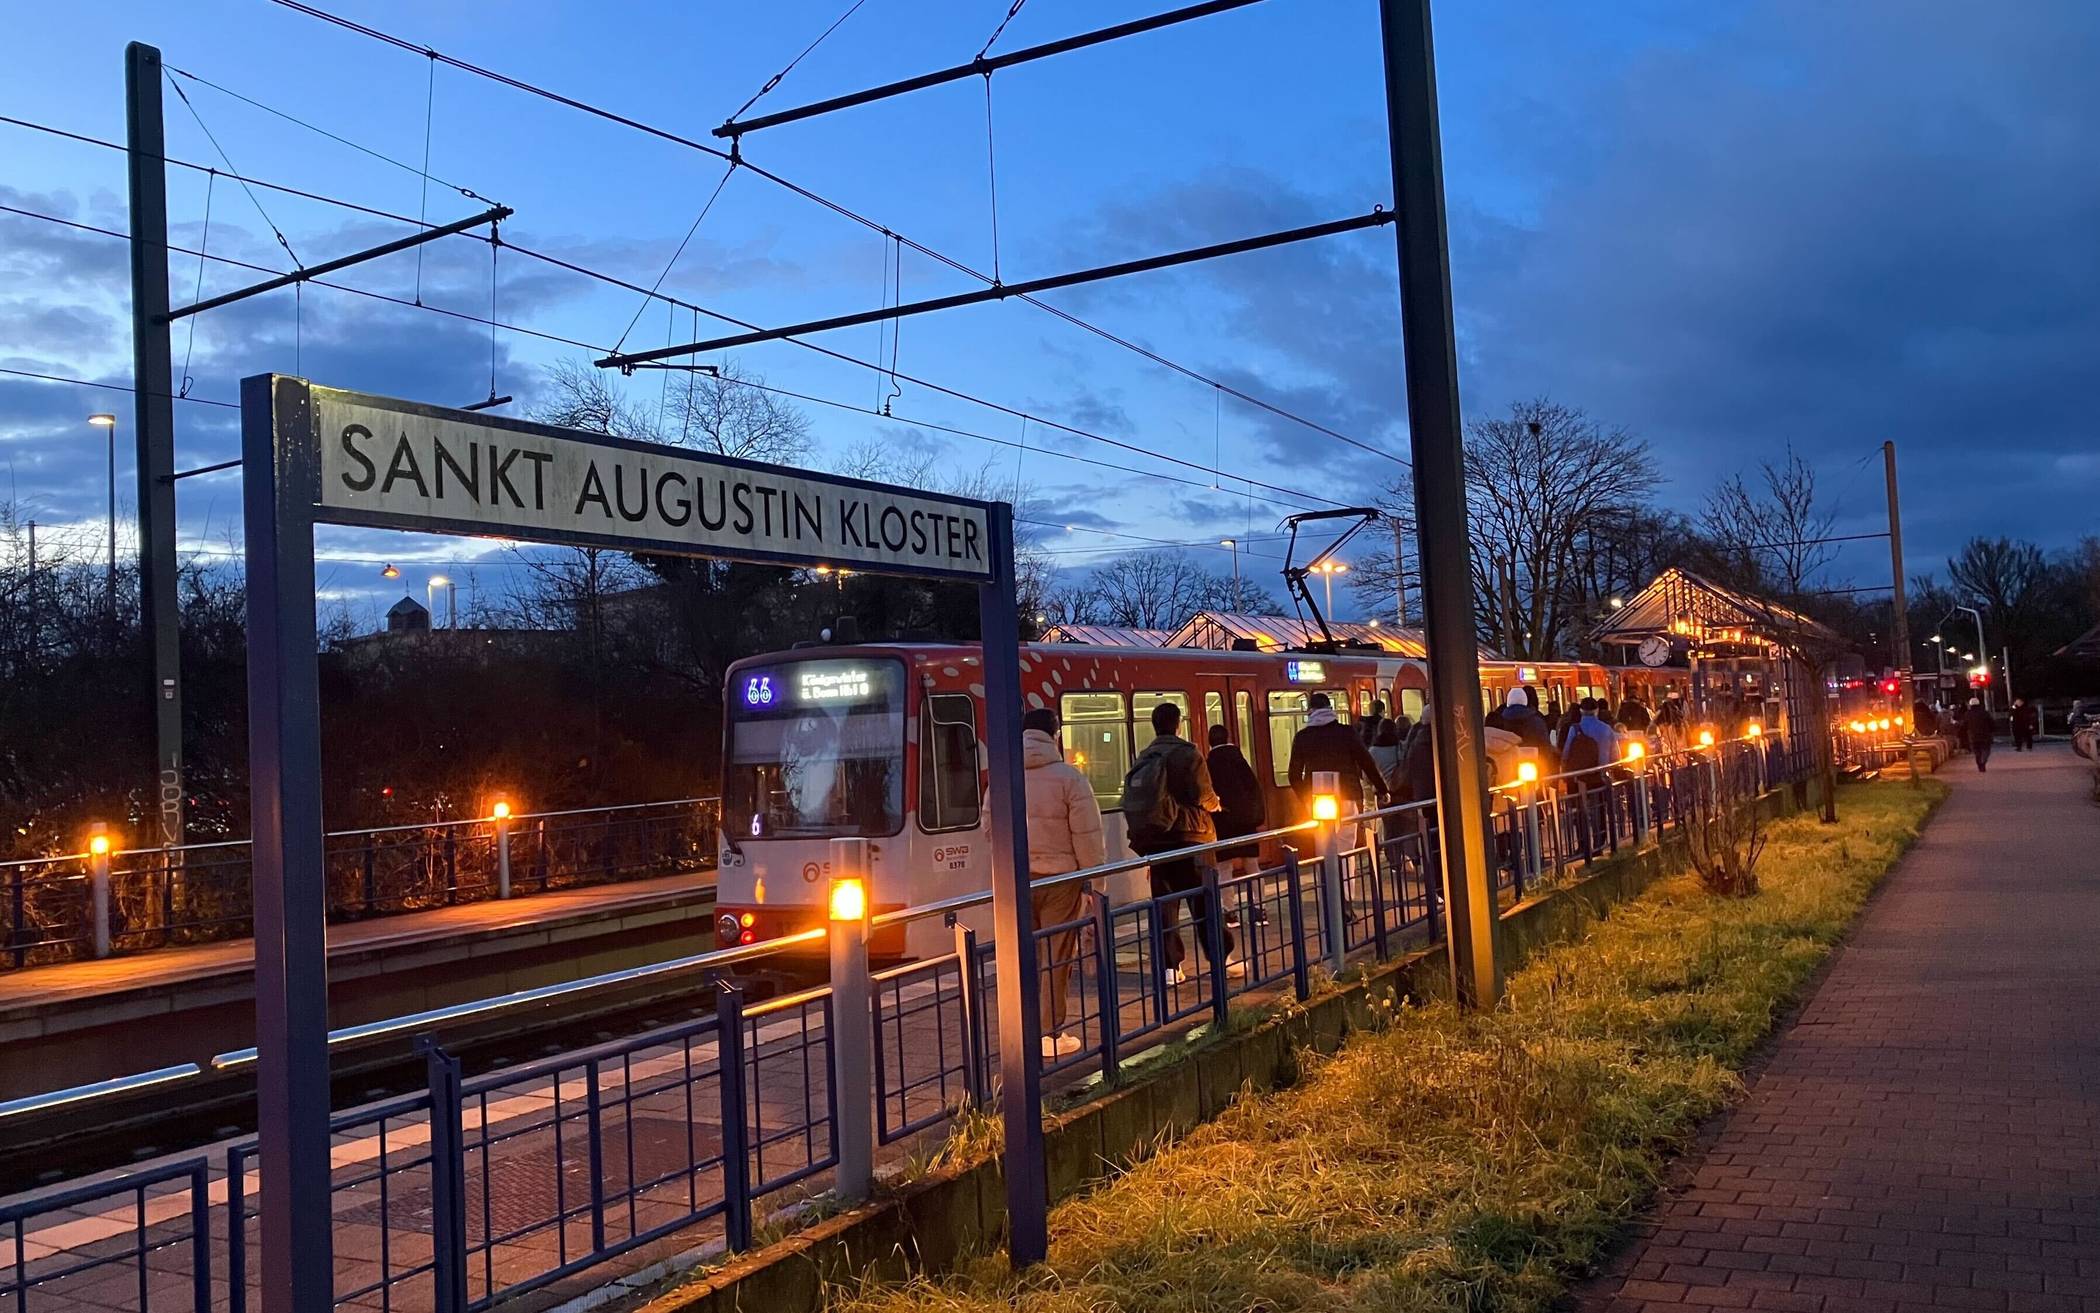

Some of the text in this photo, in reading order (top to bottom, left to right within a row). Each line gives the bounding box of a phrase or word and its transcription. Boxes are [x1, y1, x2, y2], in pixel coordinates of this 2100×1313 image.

[340, 423, 982, 561] SANKT AUGUSTIN KLOSTER
[747, 676, 772, 705] 66
